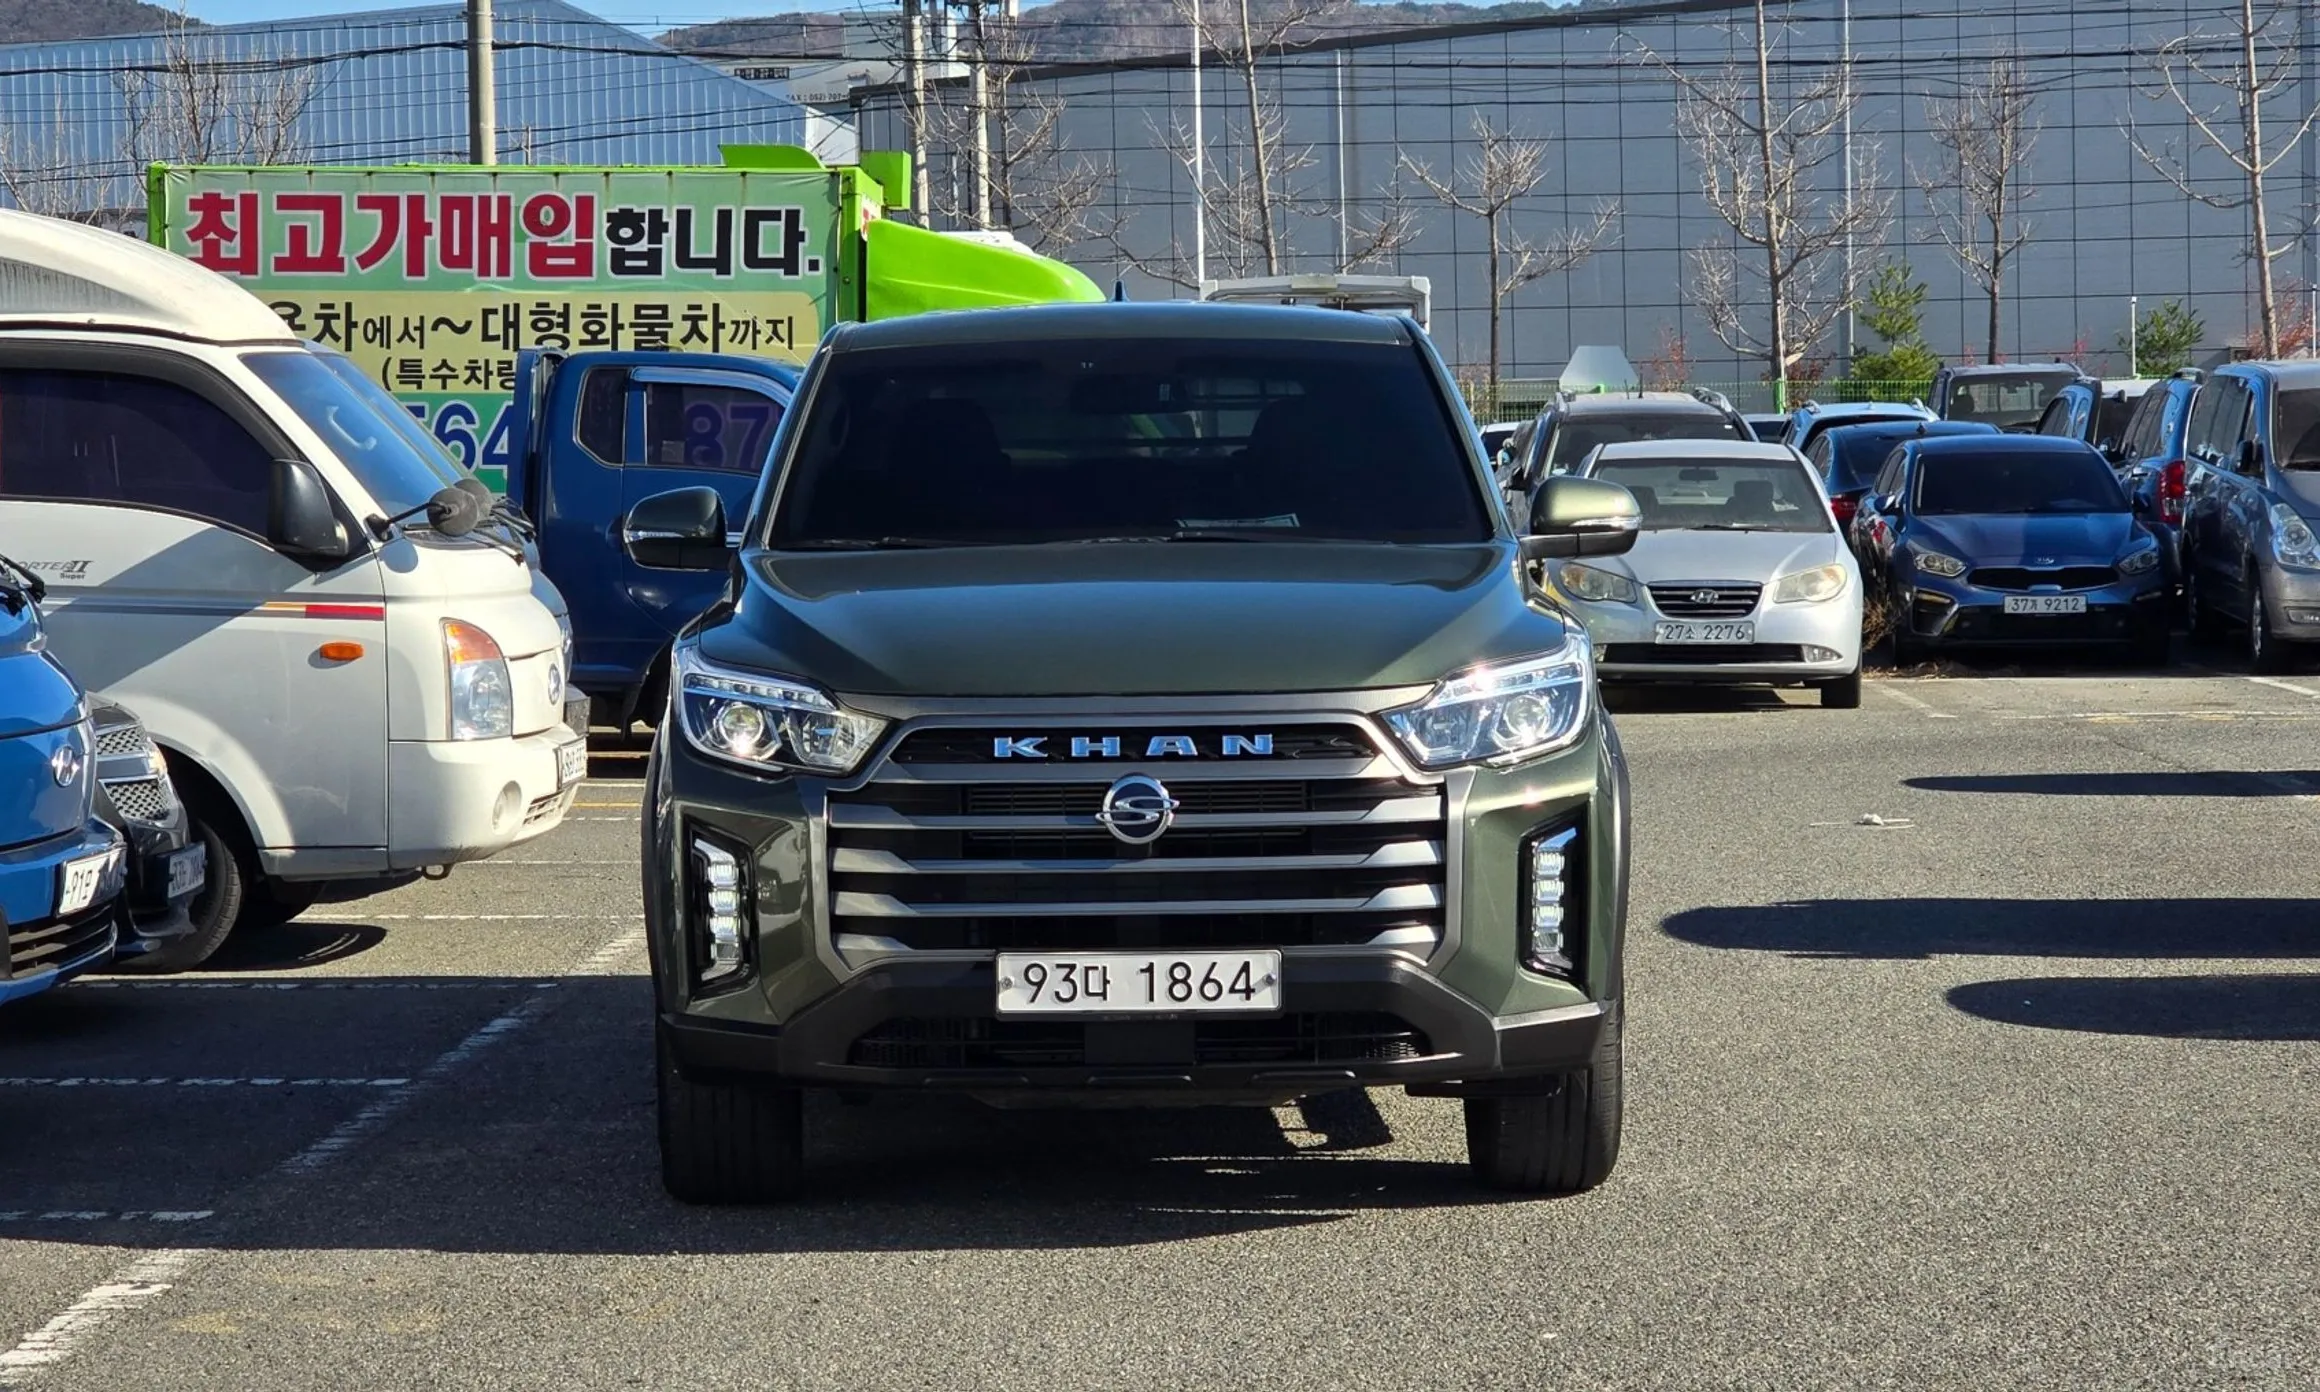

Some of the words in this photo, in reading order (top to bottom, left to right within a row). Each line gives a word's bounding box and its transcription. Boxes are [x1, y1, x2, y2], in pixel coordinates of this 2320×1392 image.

[186, 191, 821, 278] 최고가매입합니다.
[405, 403, 512, 471] 64
[2044, 598, 2080, 611] 9212
[1665, 624, 1696, 640] 27소
[1704, 624, 1745, 640] 2276
[993, 733, 1274, 758] KHAN
[1022, 962, 1112, 1004] 93다
[1139, 960, 1256, 1003] 1864
